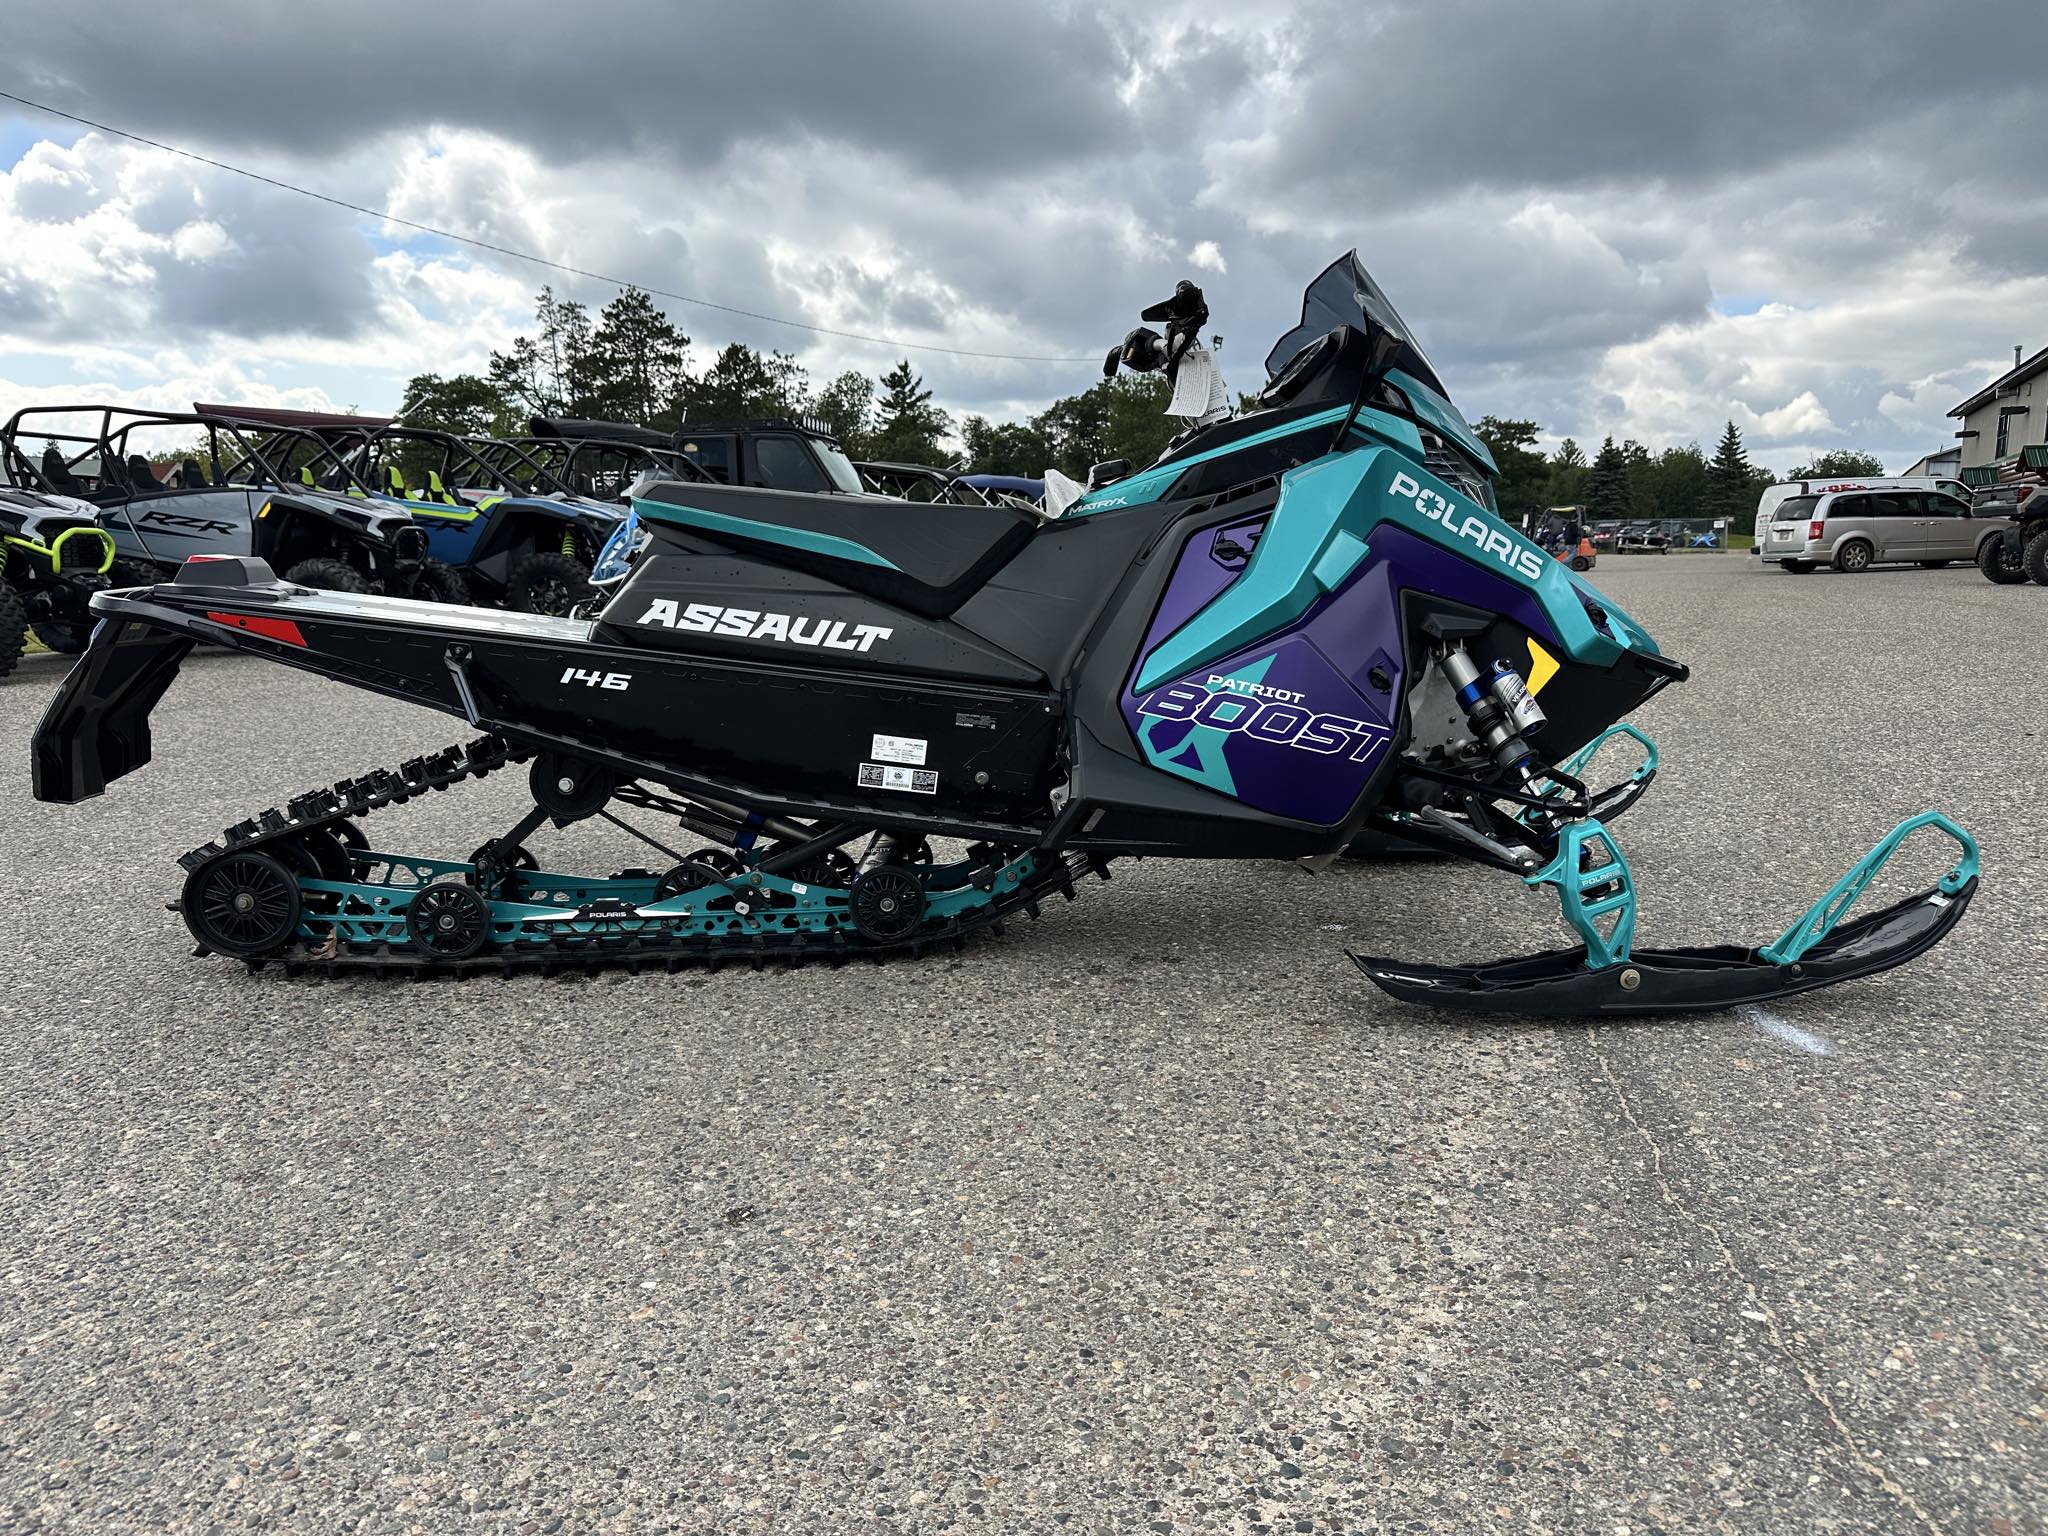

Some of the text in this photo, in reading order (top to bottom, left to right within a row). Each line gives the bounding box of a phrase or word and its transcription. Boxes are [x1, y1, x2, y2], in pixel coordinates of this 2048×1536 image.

[1068, 496, 1128, 516] MATRYX
[139, 511, 239, 535] RZR
[1388, 471, 1544, 580] POLARIS
[636, 598, 894, 652] ASSAULT
[560, 667, 632, 692] 146
[1207, 674, 1305, 704] PATRIOT
[1136, 681, 1391, 762] BOOST
